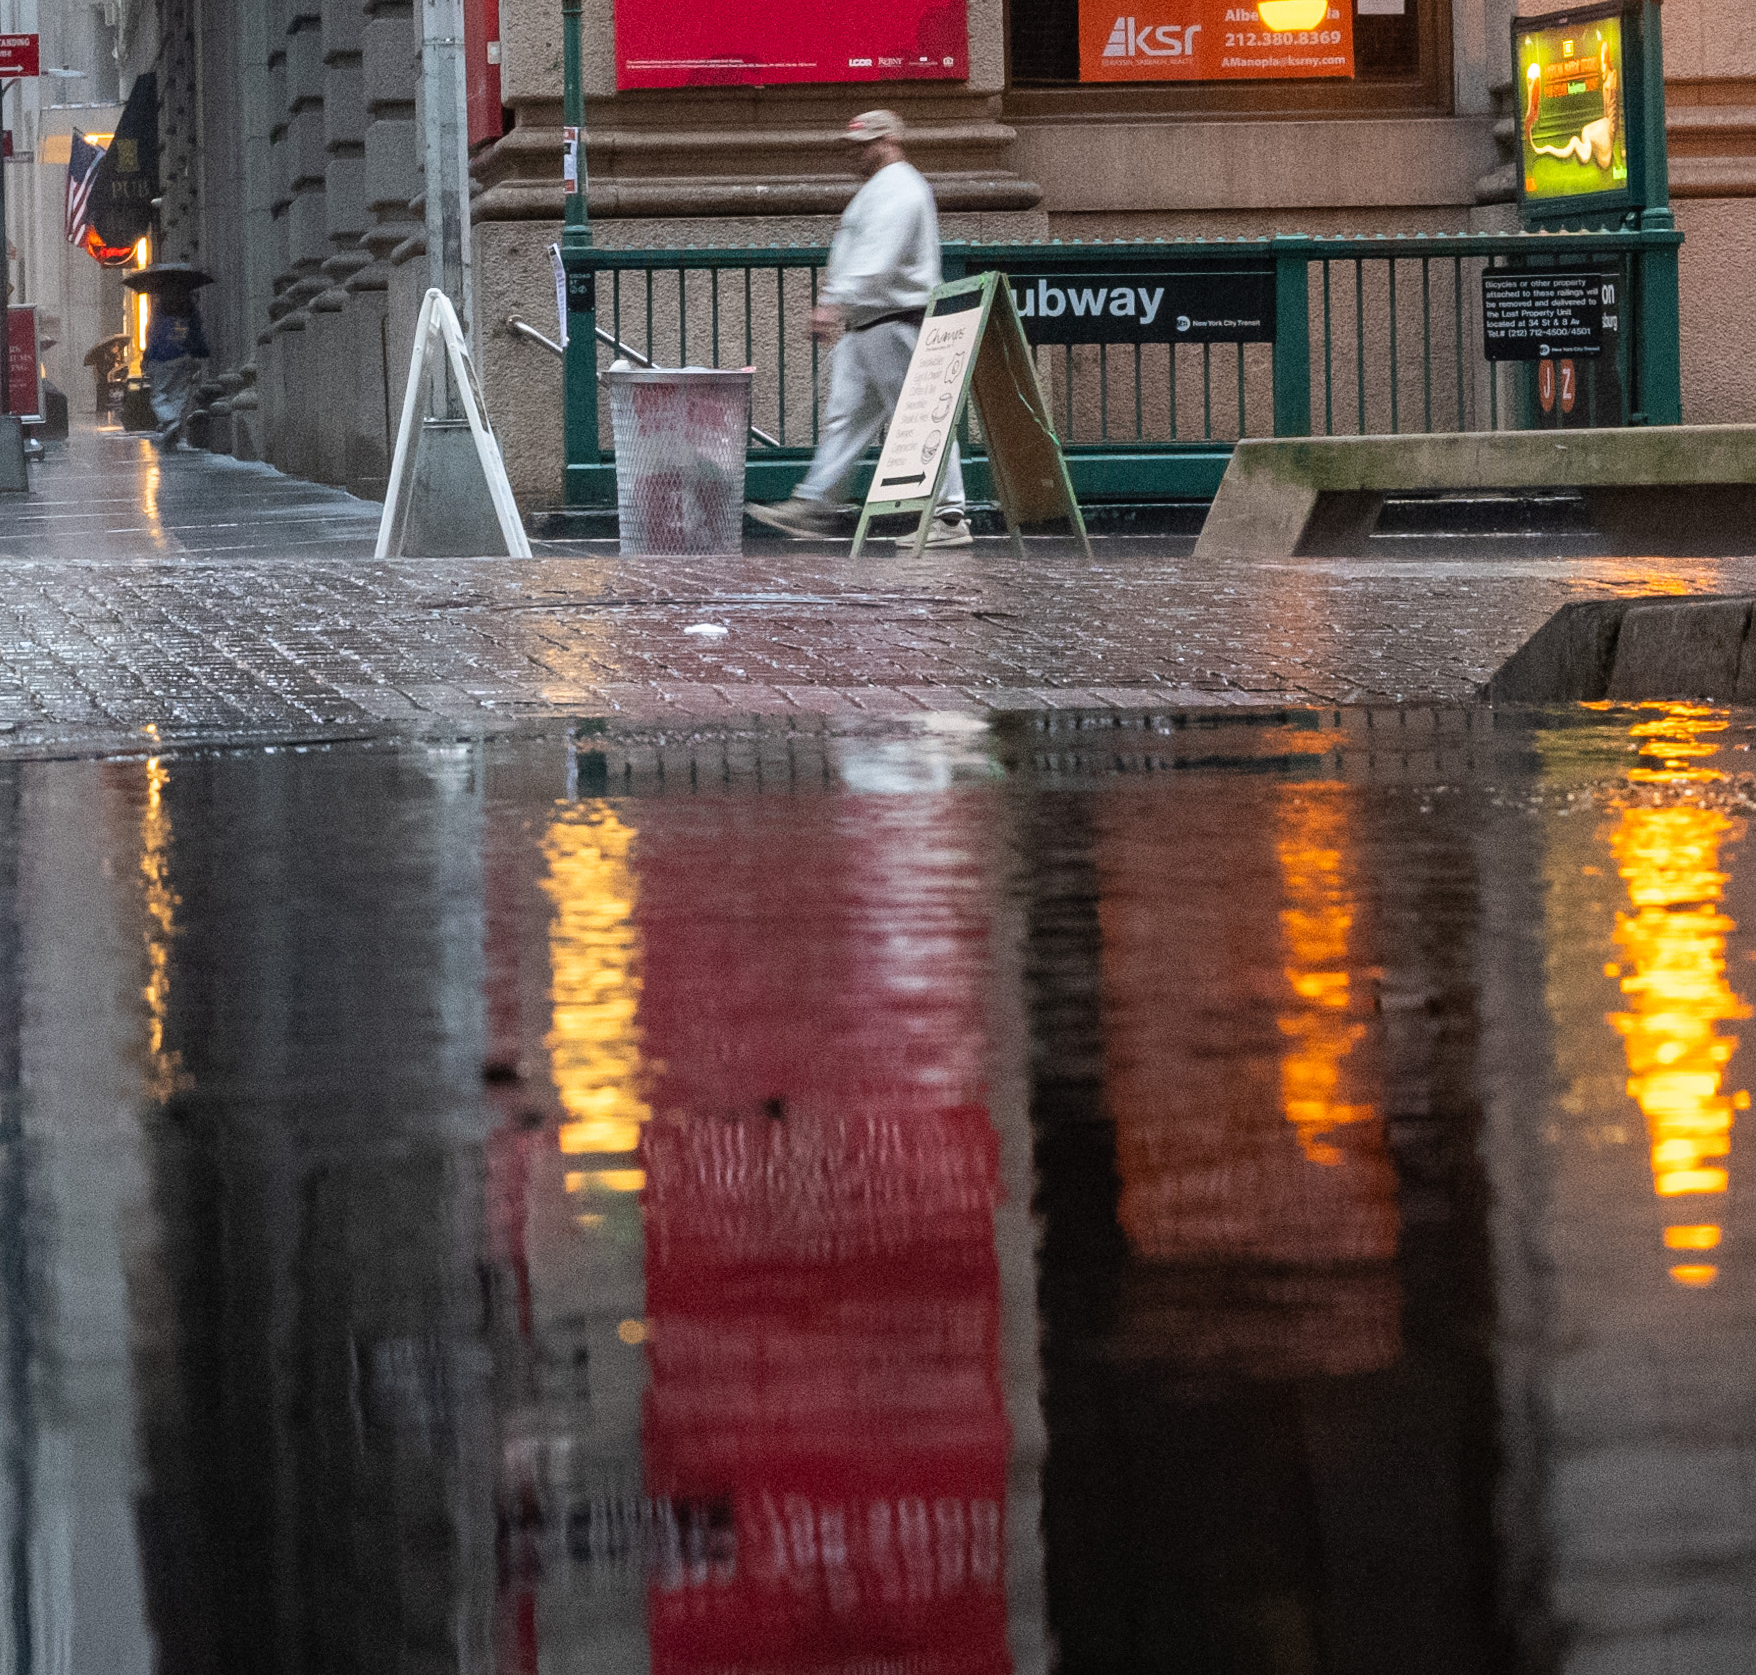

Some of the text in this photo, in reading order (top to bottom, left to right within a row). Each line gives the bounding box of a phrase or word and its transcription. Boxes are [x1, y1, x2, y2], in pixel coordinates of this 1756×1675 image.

[1127, 16, 1202, 57] ksr
[1485, 281, 1517, 289] Bicycles
[1553, 279, 1586, 288] property
[1557, 289, 1584, 297] railings
[1011, 279, 1164, 325] ubway
[1499, 300, 1532, 308] removed
[1551, 298, 1586, 306] delivered
[1521, 310, 1554, 319] Property
[1224, 319, 1236, 327] City
[1529, 319, 1539, 327] 34
[1570, 318, 1580, 326] Av
[1508, 329, 1528, 338] (212)
[1544, 367, 1571, 399] J Z
